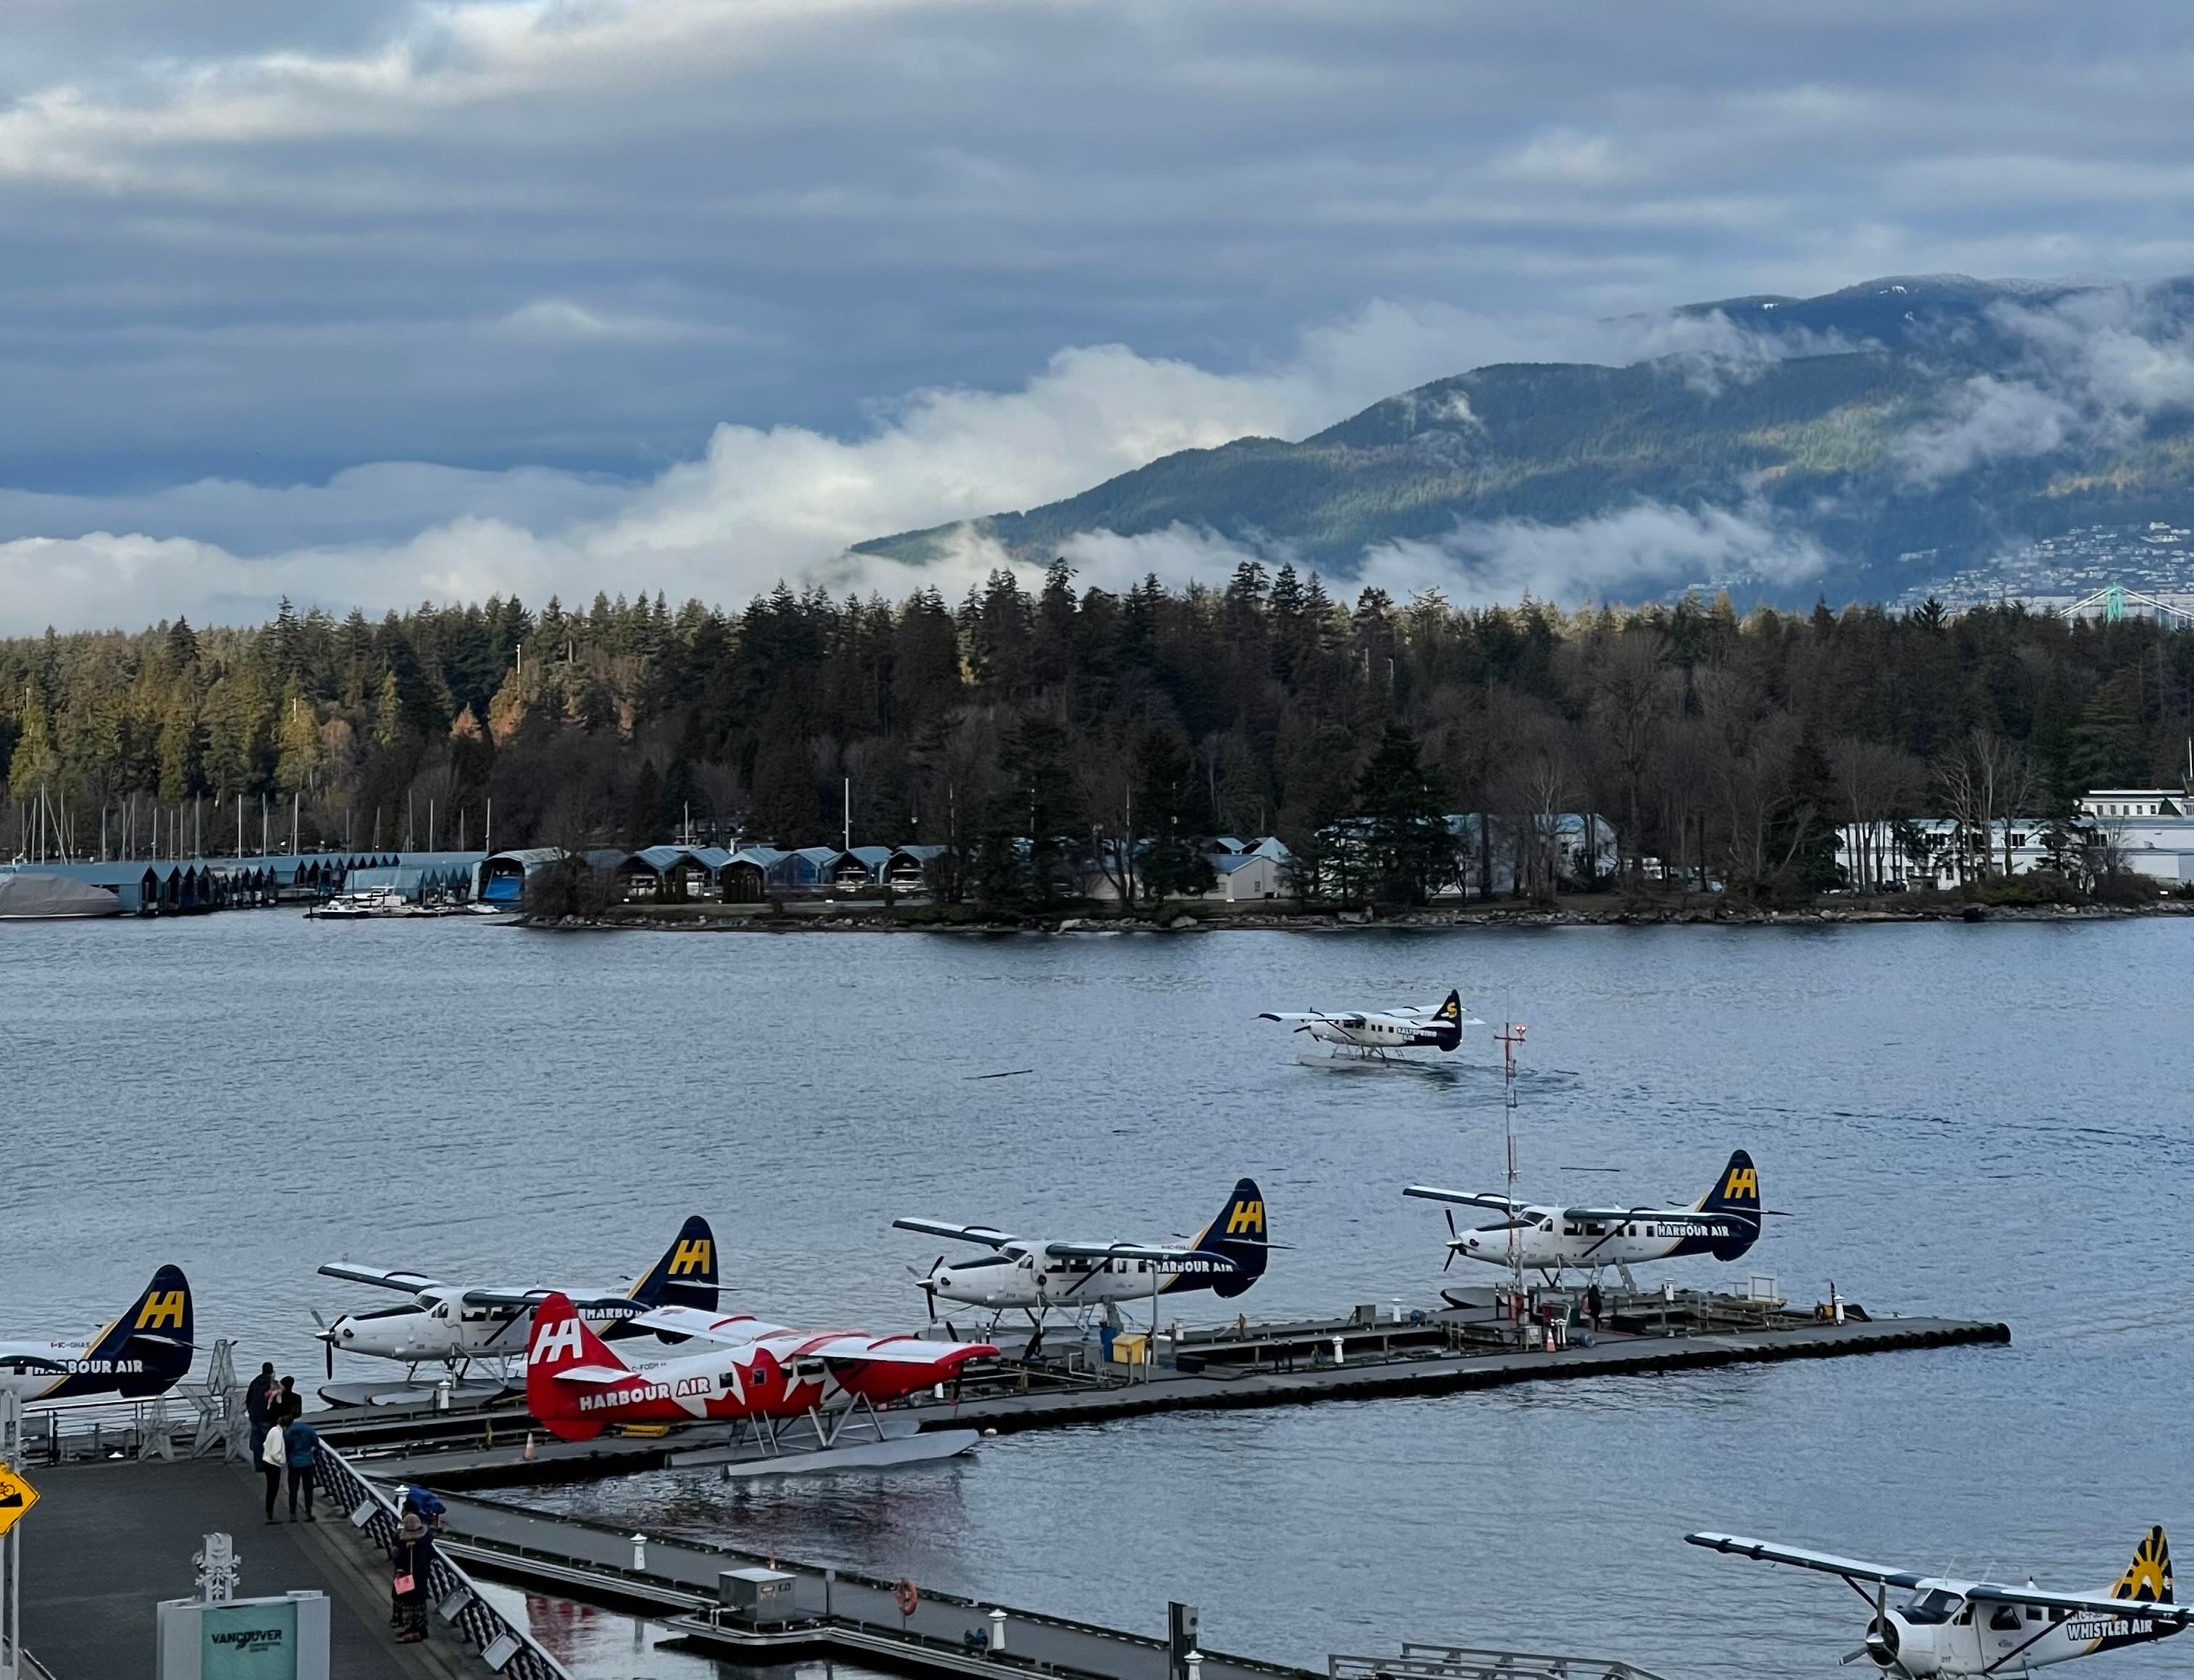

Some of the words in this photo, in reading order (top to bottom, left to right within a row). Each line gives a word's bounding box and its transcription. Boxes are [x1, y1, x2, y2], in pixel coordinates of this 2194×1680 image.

[1447, 1001, 1458, 1018] S
[1658, 1225, 1709, 1237] HARBOUR
[1711, 1225, 1730, 1237] AIR
[1213, 1261, 1234, 1273] AIR
[586, 1308, 643, 1320] HARBO
[34, 1360, 113, 1375] HBOUR
[115, 1359, 143, 1373] AIR
[580, 1383, 670, 1411] HARBOUR
[677, 1377, 711, 1397] AIR
[211, 1629, 282, 1644] VANCOUVER
[2067, 1619, 2129, 1641] WHISTLER
[2131, 1618, 2153, 1635] AIR
